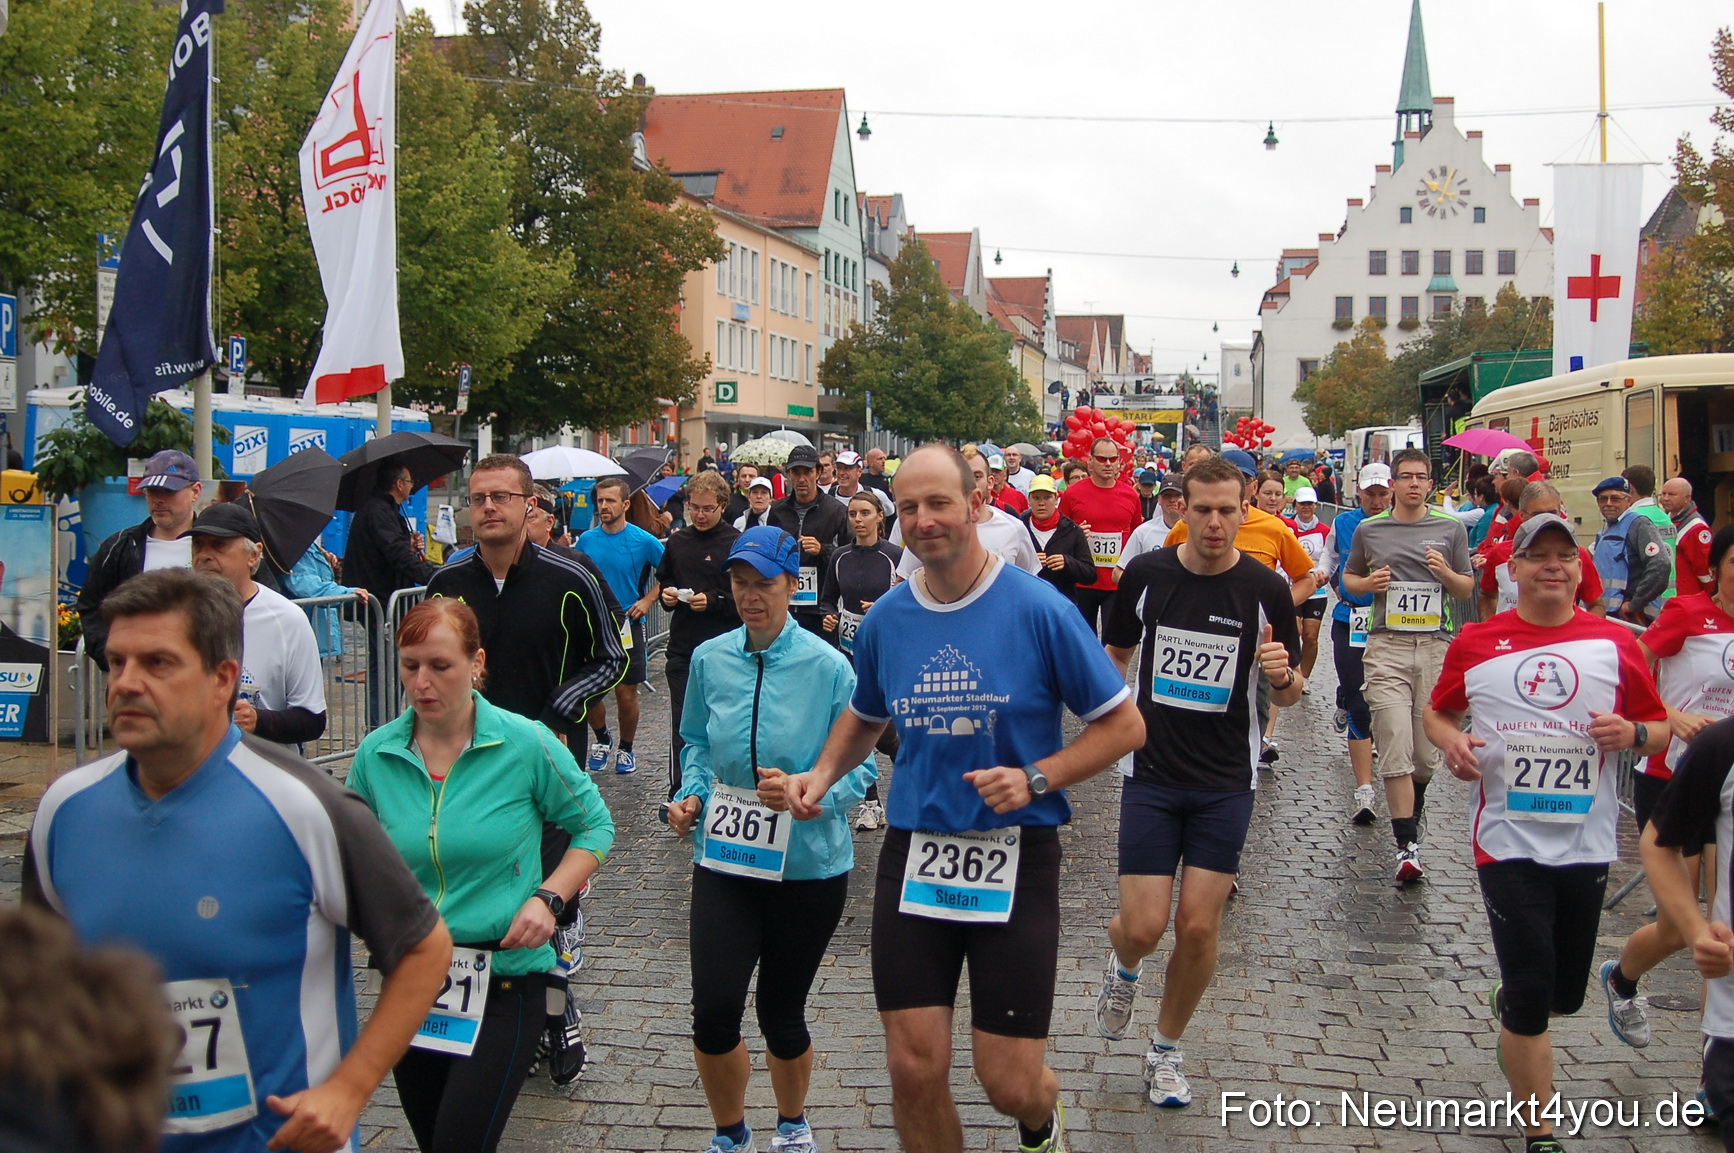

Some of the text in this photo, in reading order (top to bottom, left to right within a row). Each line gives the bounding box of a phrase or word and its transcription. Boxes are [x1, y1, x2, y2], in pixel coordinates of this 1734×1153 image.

[2, 303, 13, 349] P
[232, 340, 242, 371] P
[461, 370, 469, 390] P
[718, 384, 734, 400] D
[89, 382, 134, 429] obile.de
[1123, 412, 1153, 420] START
[1549, 408, 1599, 435] Bayerisches
[1548, 437, 1572, 456] Rotes
[1094, 541, 1116, 554] 313
[1398, 594, 1430, 612] 417
[1401, 616, 1426, 624] Dennis
[1157, 634, 1224, 651] PARTL Neumarkt
[1160, 647, 1229, 683] 2527
[1167, 683, 1211, 700] Andreas
[891, 693, 1010, 715] 13. Neumarkter Stadtlauf
[1506, 744, 1583, 755] PARTL Neumarkt
[1514, 757, 1591, 790] 2724
[1530, 797, 1572, 813] Jürgen
[710, 804, 779, 844] 2361
[720, 845, 756, 864] Sabine
[917, 841, 1007, 884] 2362
[935, 888, 979, 907] Stefan
[450, 959, 468, 969] rkt
[418, 1020, 448, 1036] nett
